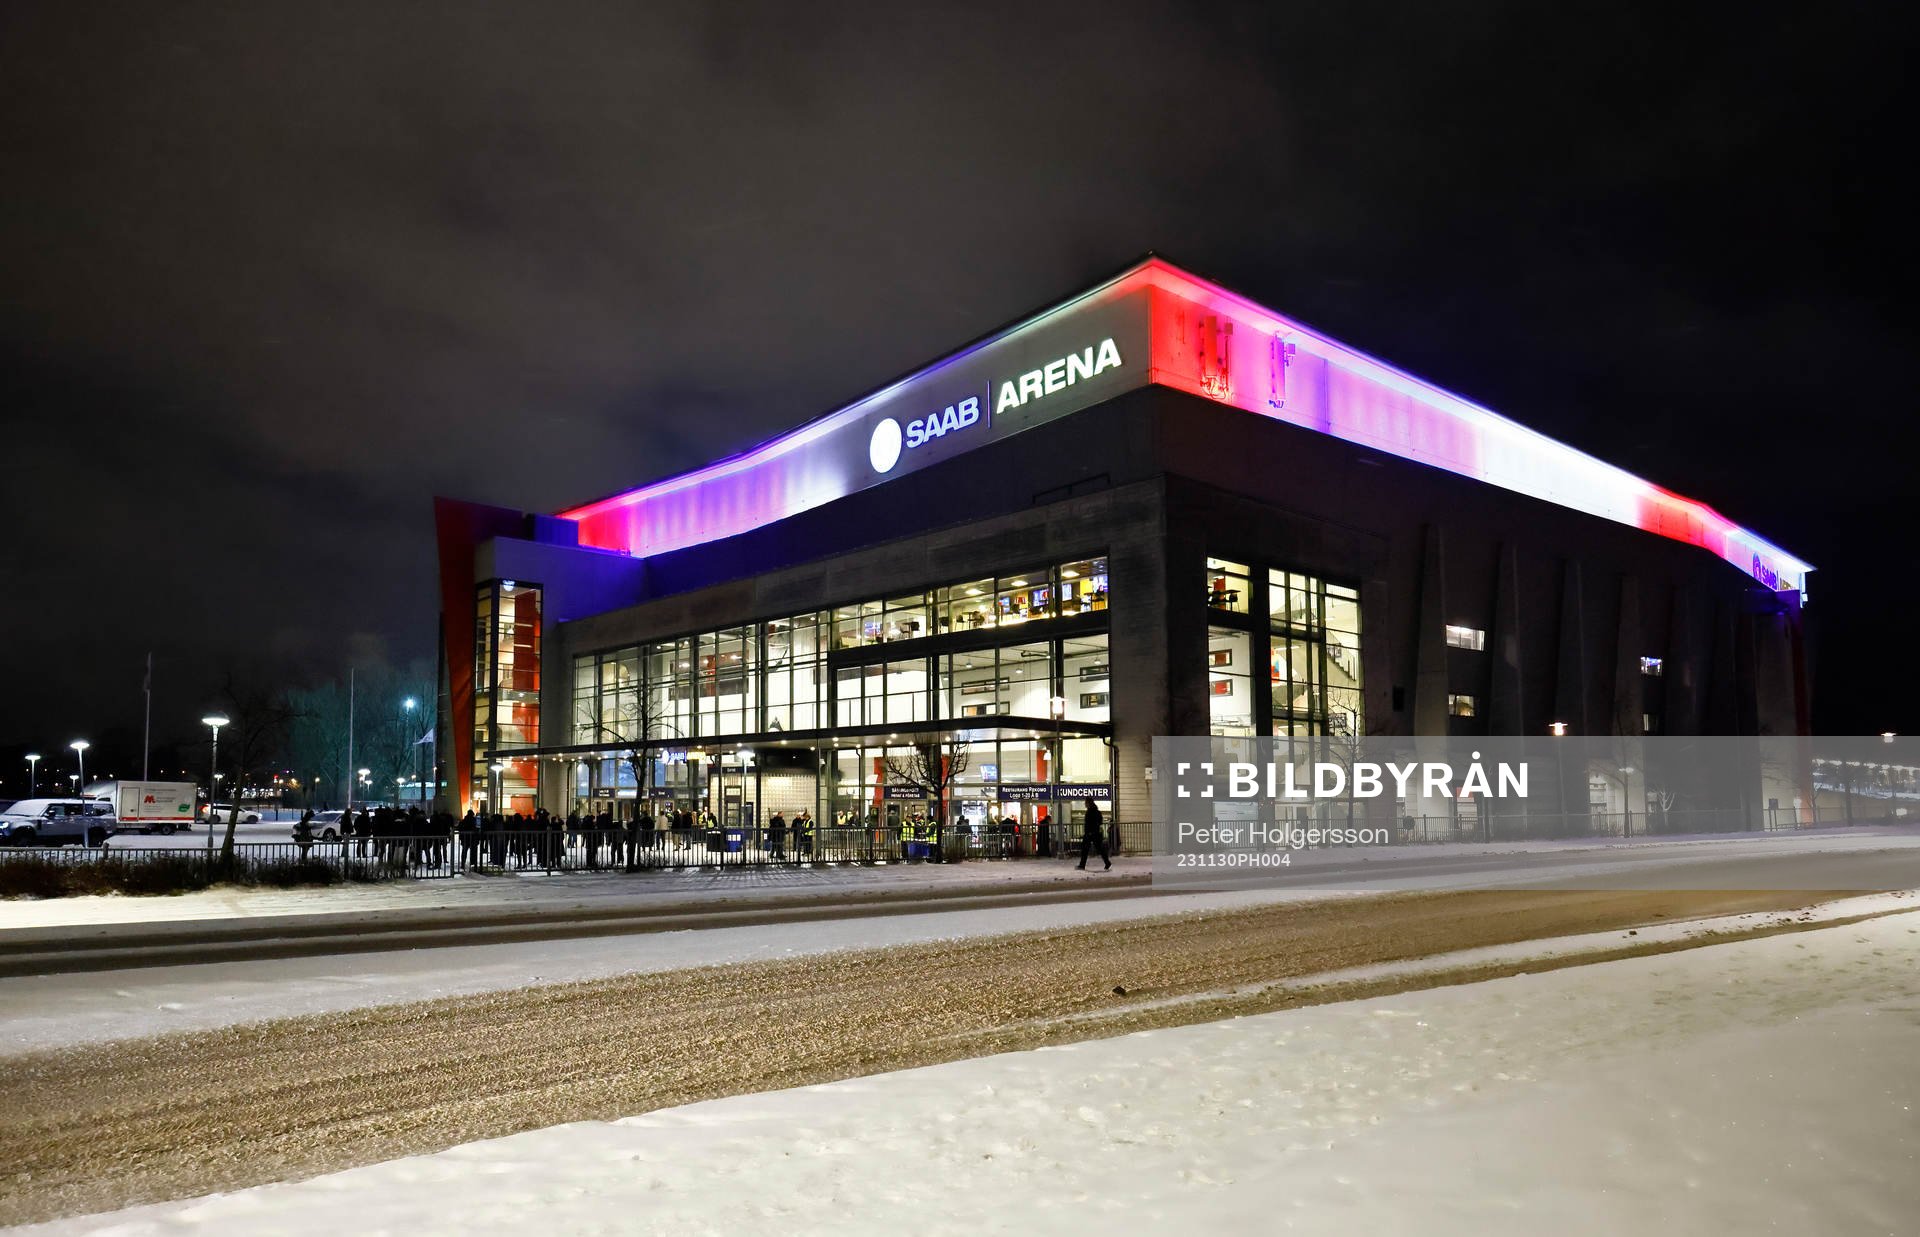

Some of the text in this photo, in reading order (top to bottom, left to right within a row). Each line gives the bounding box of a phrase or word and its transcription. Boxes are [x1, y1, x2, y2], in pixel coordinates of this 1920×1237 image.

[906, 338, 1122, 448] SAAB ARENA
[1057, 788, 1109, 797] KUNDCENTER
